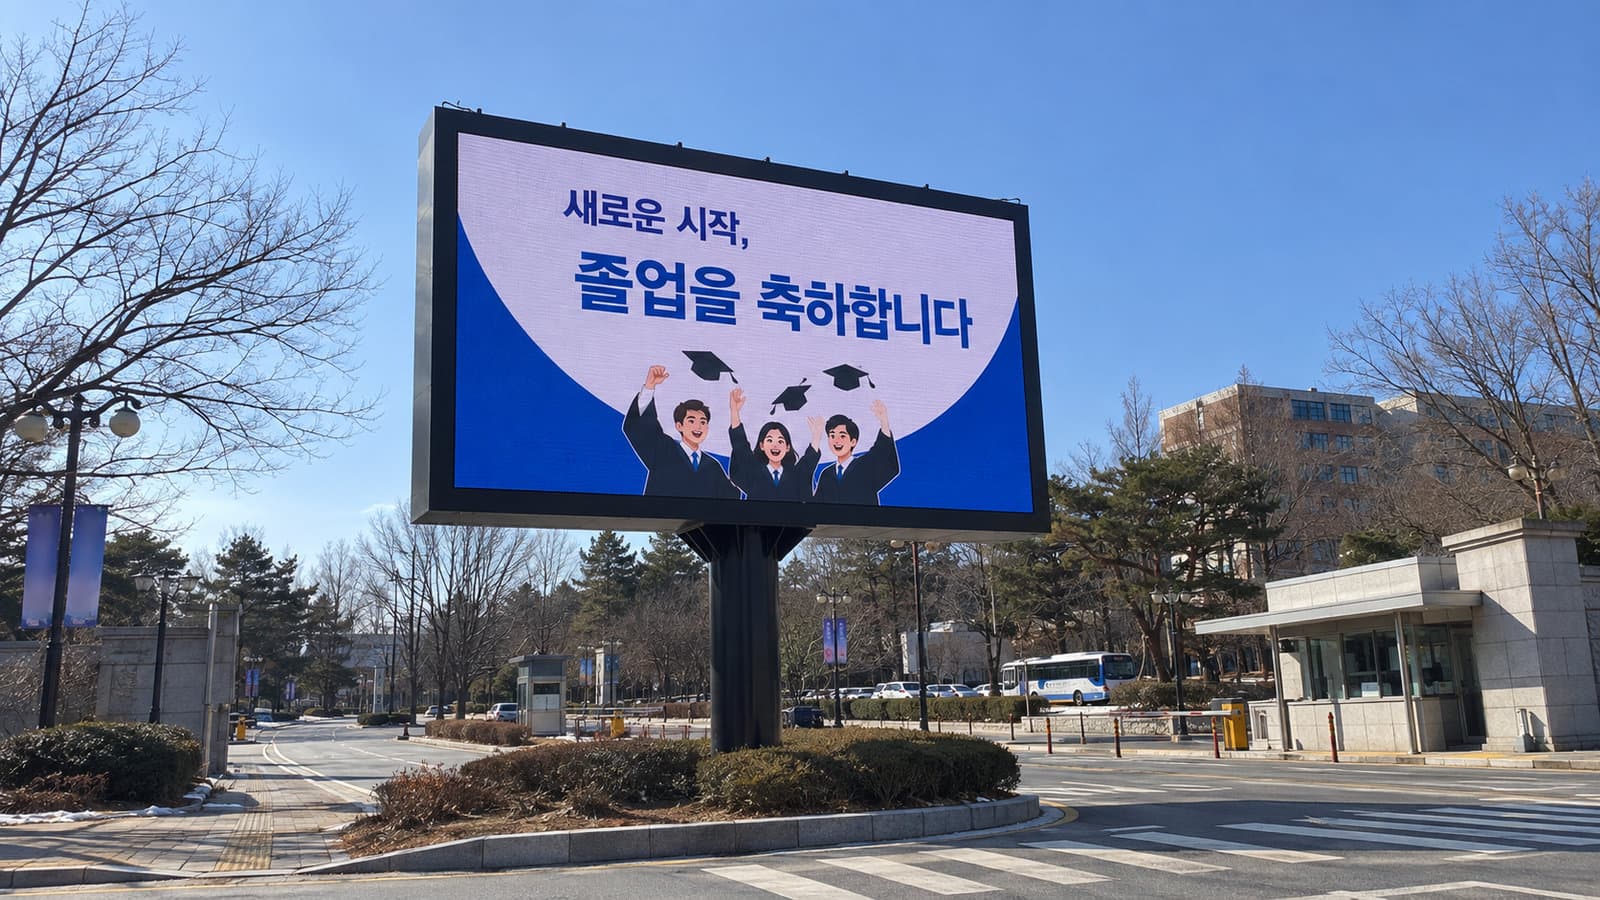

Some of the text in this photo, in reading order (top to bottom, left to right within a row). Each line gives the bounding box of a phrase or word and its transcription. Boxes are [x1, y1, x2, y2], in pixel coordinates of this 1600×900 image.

[563, 190, 748, 249] 새로운 시작,
[575, 251, 973, 348] 졸업을 축하합니다
